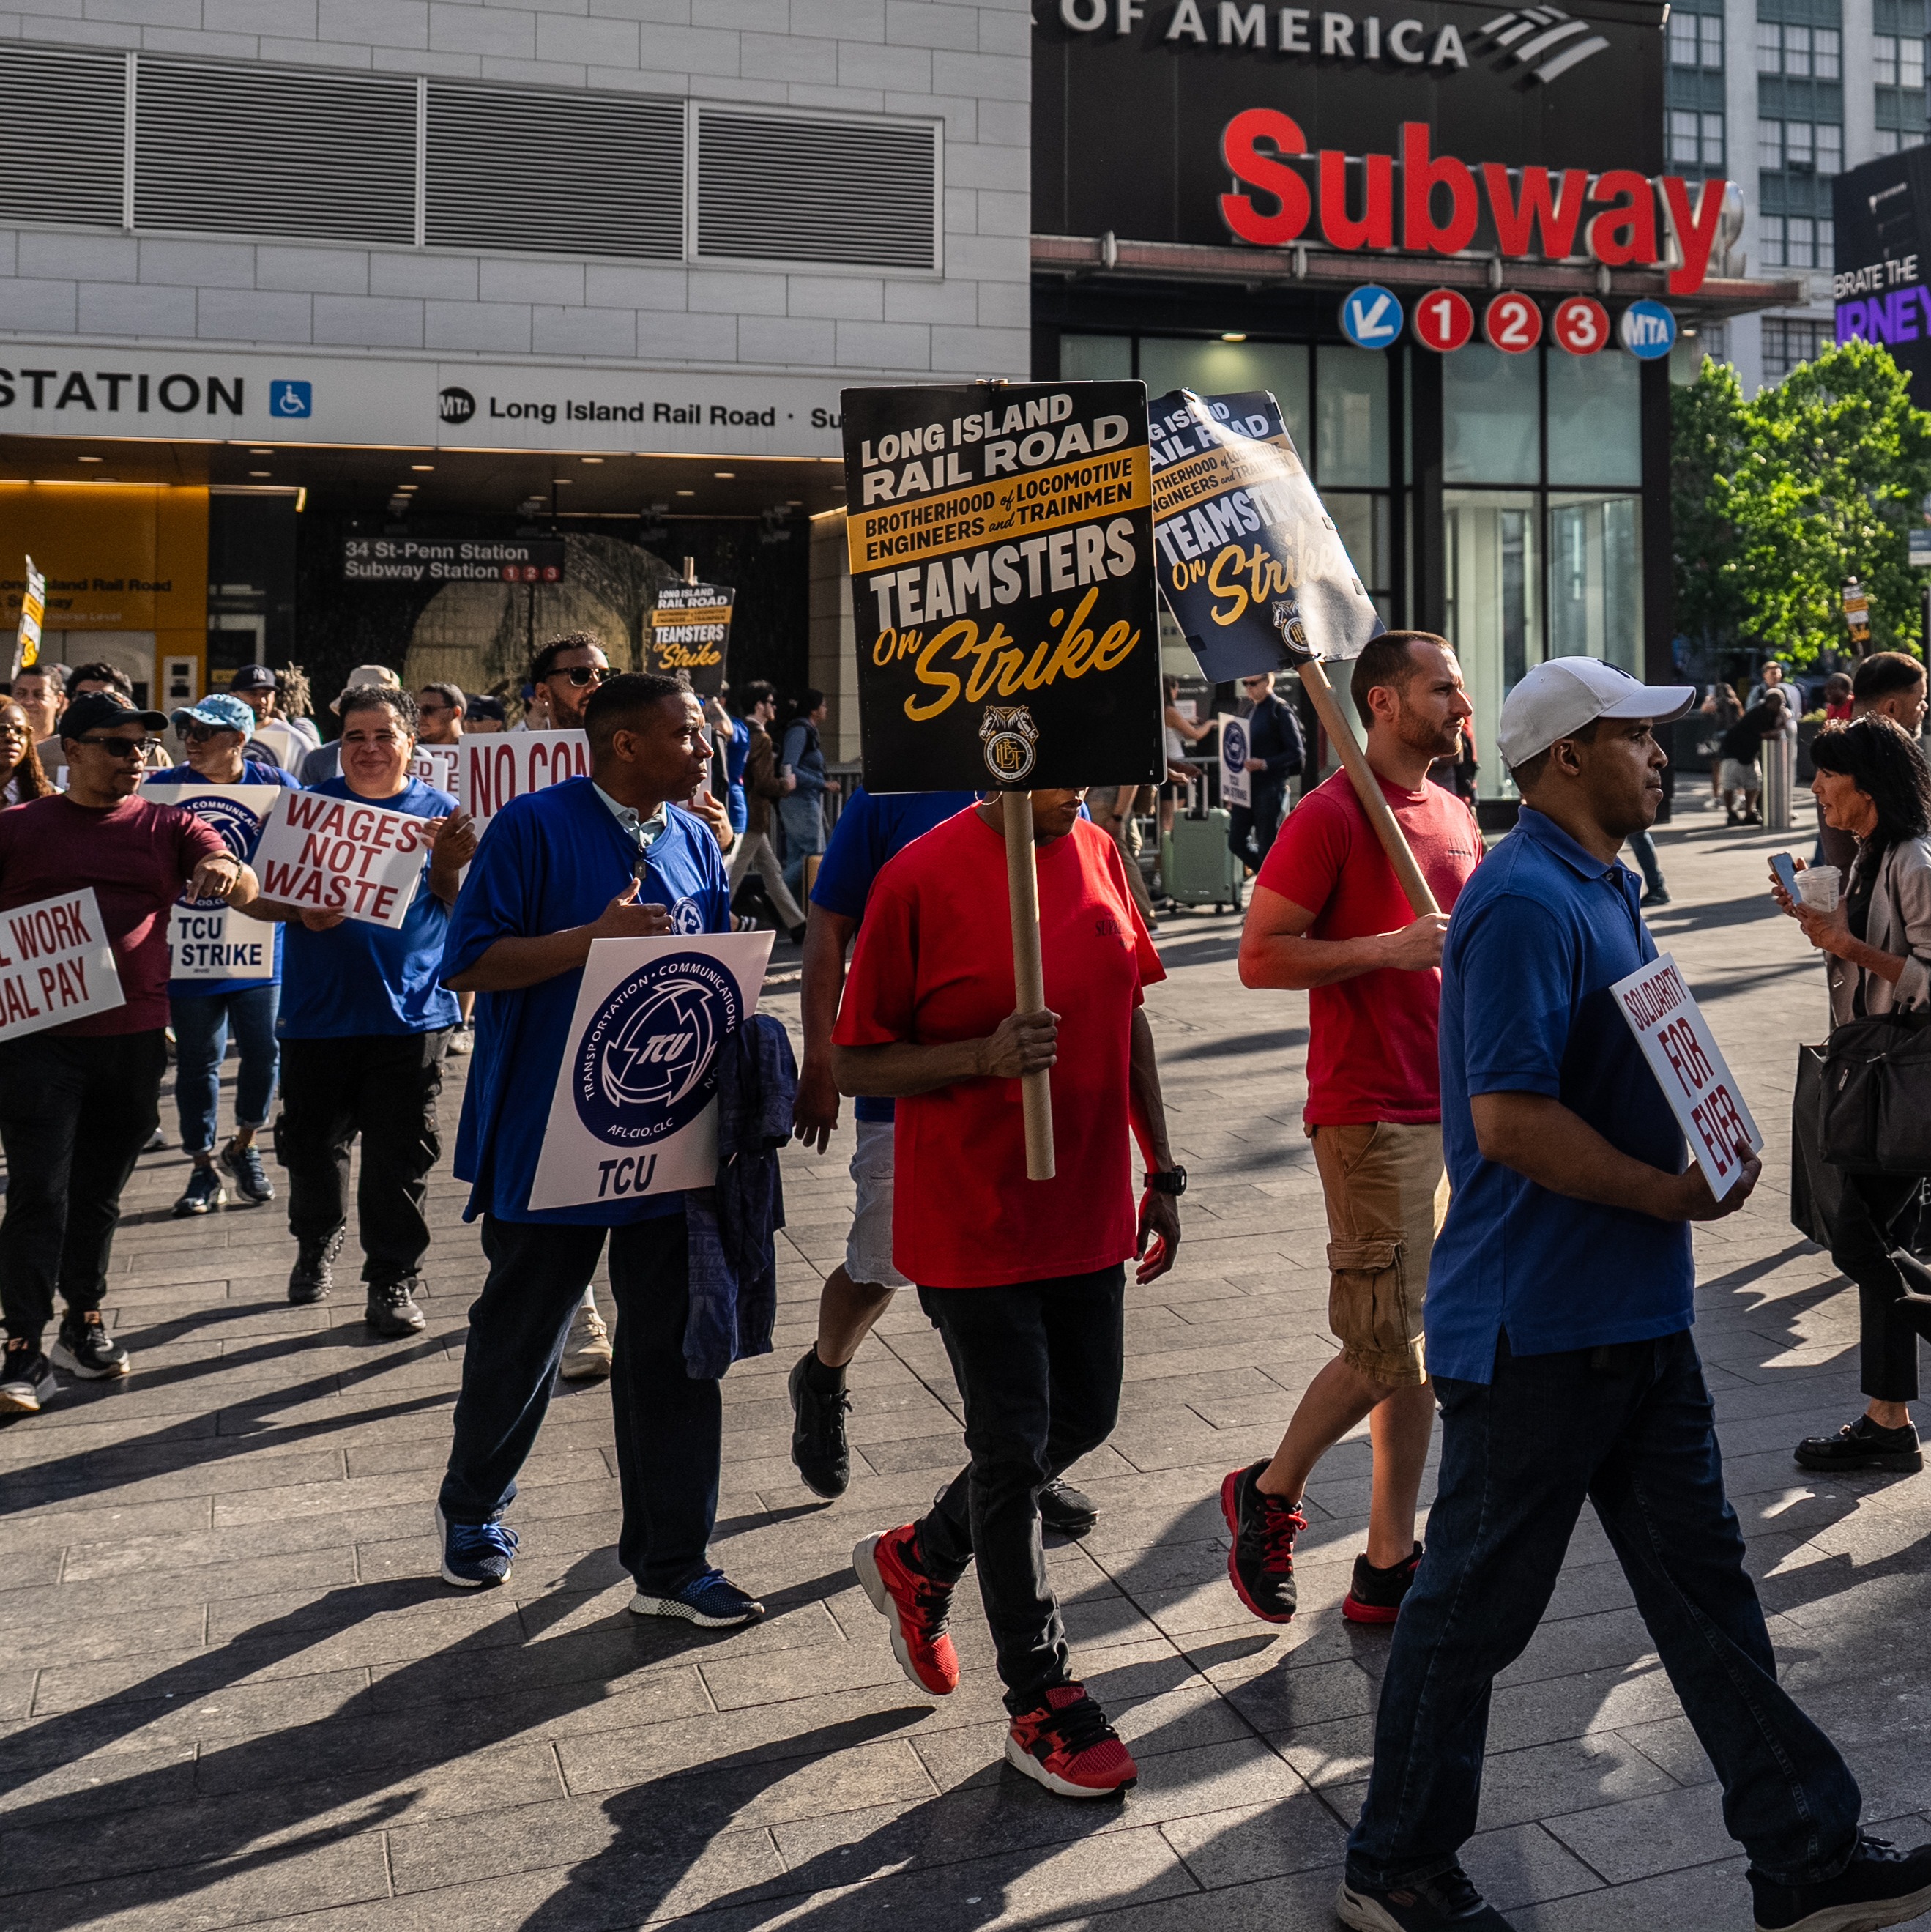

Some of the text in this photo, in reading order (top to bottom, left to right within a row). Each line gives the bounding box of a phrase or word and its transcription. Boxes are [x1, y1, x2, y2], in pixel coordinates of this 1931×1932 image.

[1060, 0, 1469, 68] OF AMERICA
[1219, 108, 1729, 294] Subway
[1833, 254, 1919, 300] BRATE THE
[1430, 299, 1670, 347] 1 2 3 MTA
[439, 395, 844, 429] MTA Long Island Rail Road Su
[861, 393, 1074, 468] LONG ISLAND
[1164, 402, 1230, 433] ISLND
[863, 415, 1129, 506] RAIL ROAD
[1150, 414, 1269, 471] AIL RAD
[865, 457, 1133, 538] BROTHERHOOD of LOCOMOTIVE
[1152, 456, 1218, 496] THERHOOD
[1220, 454, 1229, 469] of
[1153, 475, 1219, 513] NGINEERS
[1221, 473, 1236, 485] and
[866, 481, 1133, 562] ENGINEERS and TRAINMEN
[345, 541, 529, 561] 34 St-Penn Station
[345, 561, 424, 581] Subway
[430, 562, 499, 579] Station
[869, 517, 1136, 632] TEAMSTERS
[1172, 520, 1338, 625] On Strike
[658, 587, 714, 599] LONG ISLAND
[658, 595, 728, 609] RAIL ROAD
[655, 624, 726, 644] TEAMSTERS
[658, 641, 722, 669] Strike
[872, 587, 1141, 721] On Strike
[470, 744, 516, 817] NO
[286, 793, 423, 852] WAGES
[298, 833, 382, 878] NOT
[264, 860, 398, 920] WASTE
[8, 900, 92, 961] WORK
[178, 917, 223, 940] TCU
[181, 943, 262, 966] STRIKE
[37, 956, 89, 1011] PAY
[1623, 965, 1687, 1032] SOLIDARITY
[584, 962, 735, 1101] TRANSPORTATION COMMUNICATIONS
[636, 1033, 694, 1065] TCU
[1656, 1017, 1715, 1099] FOR
[1690, 1084, 1752, 1178] EVER
[598, 1153, 658, 1197] TCU
